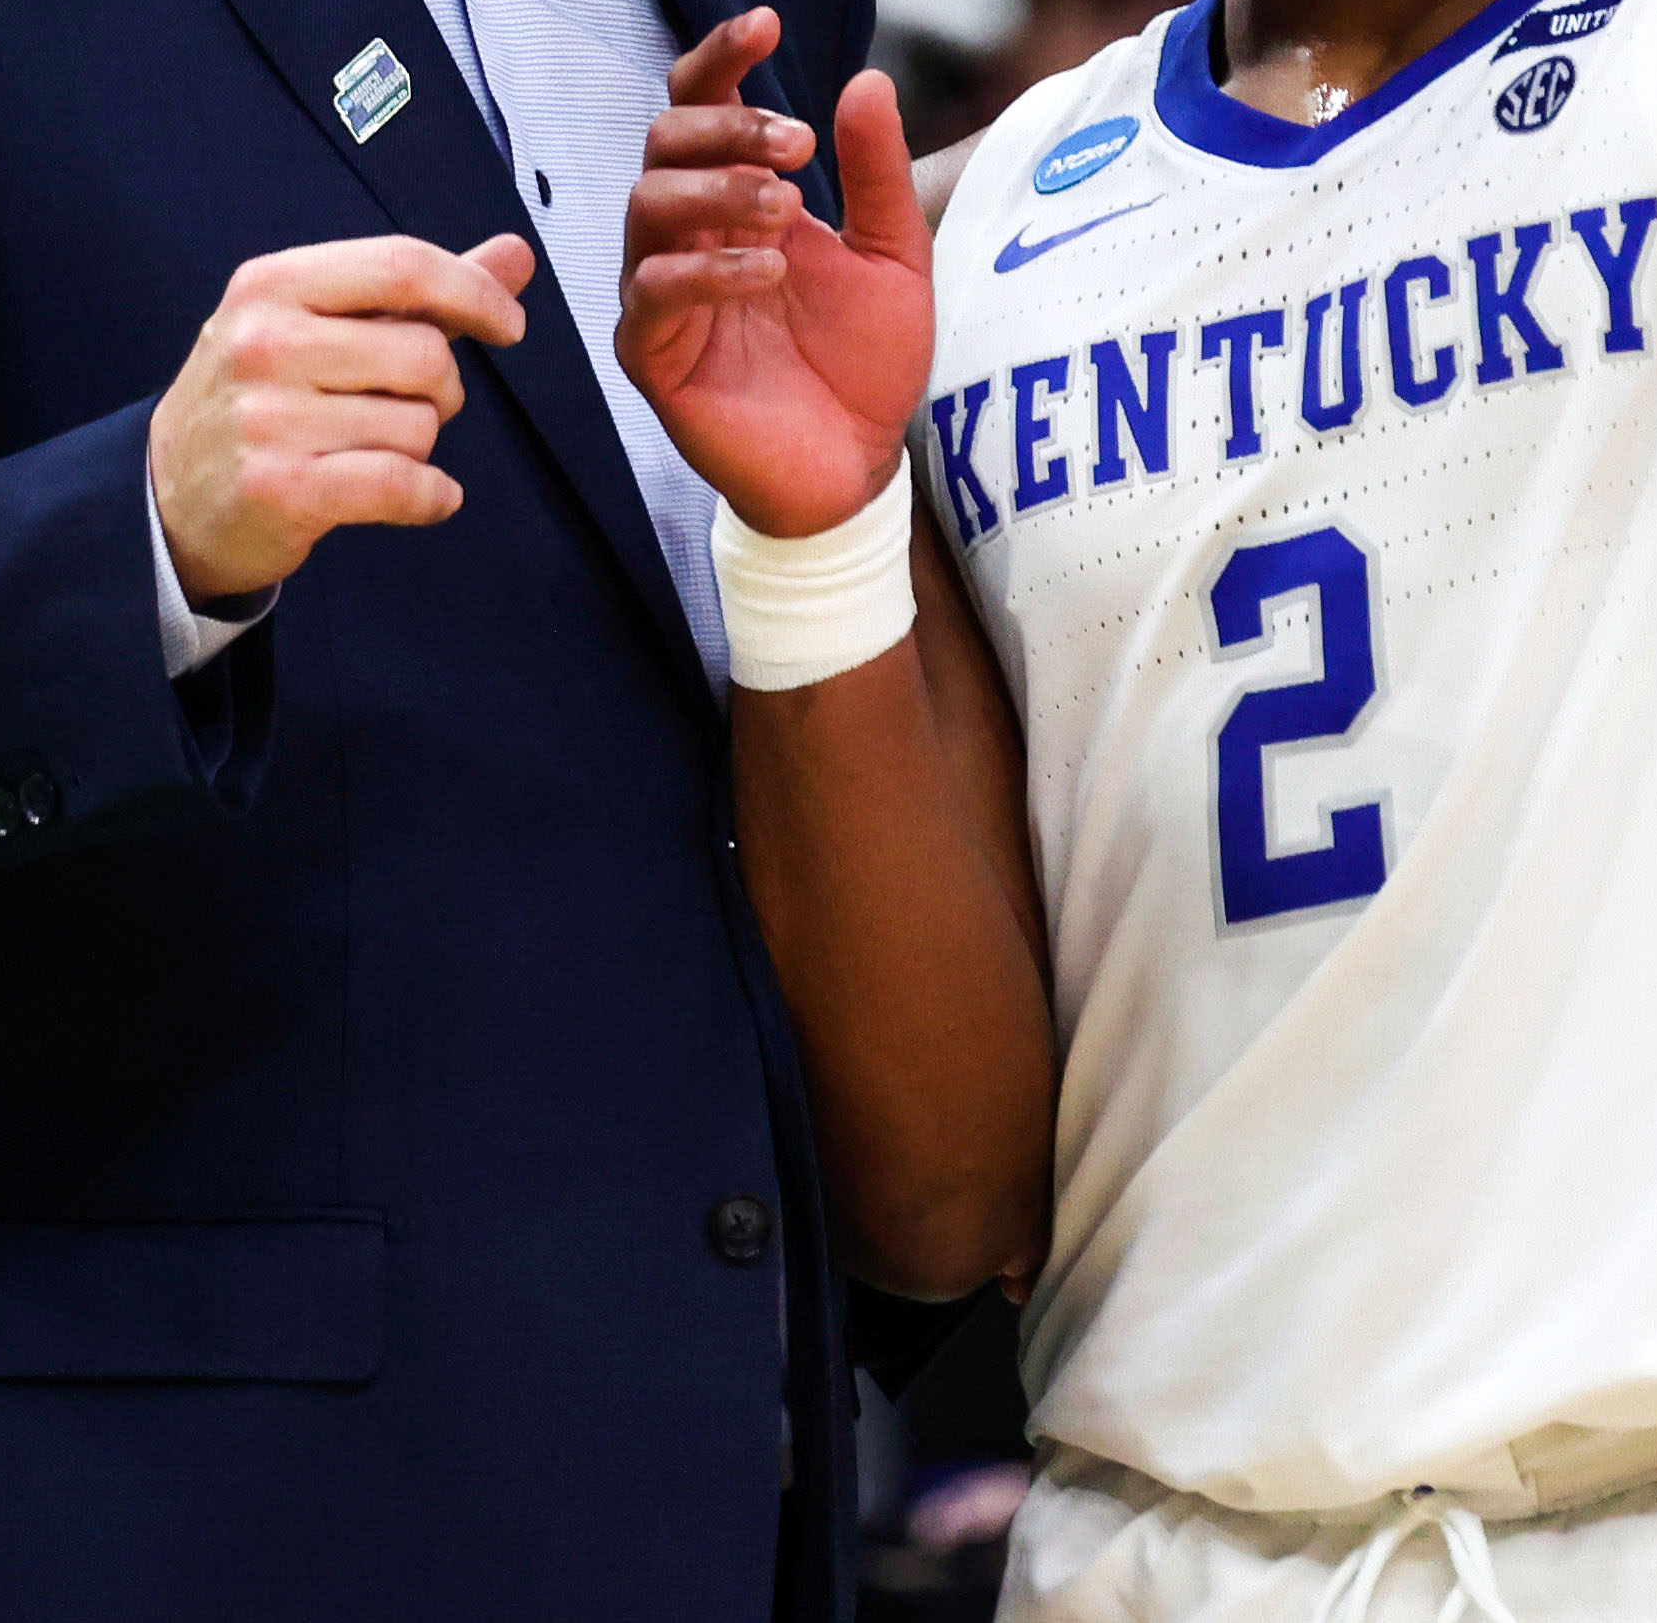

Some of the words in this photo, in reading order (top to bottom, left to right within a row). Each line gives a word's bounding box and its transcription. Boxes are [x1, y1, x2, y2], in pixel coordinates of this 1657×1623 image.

[1500, 59, 1571, 127] SEC
[1044, 134, 1130, 180] NCAA
[1203, 520, 1393, 934] 2
